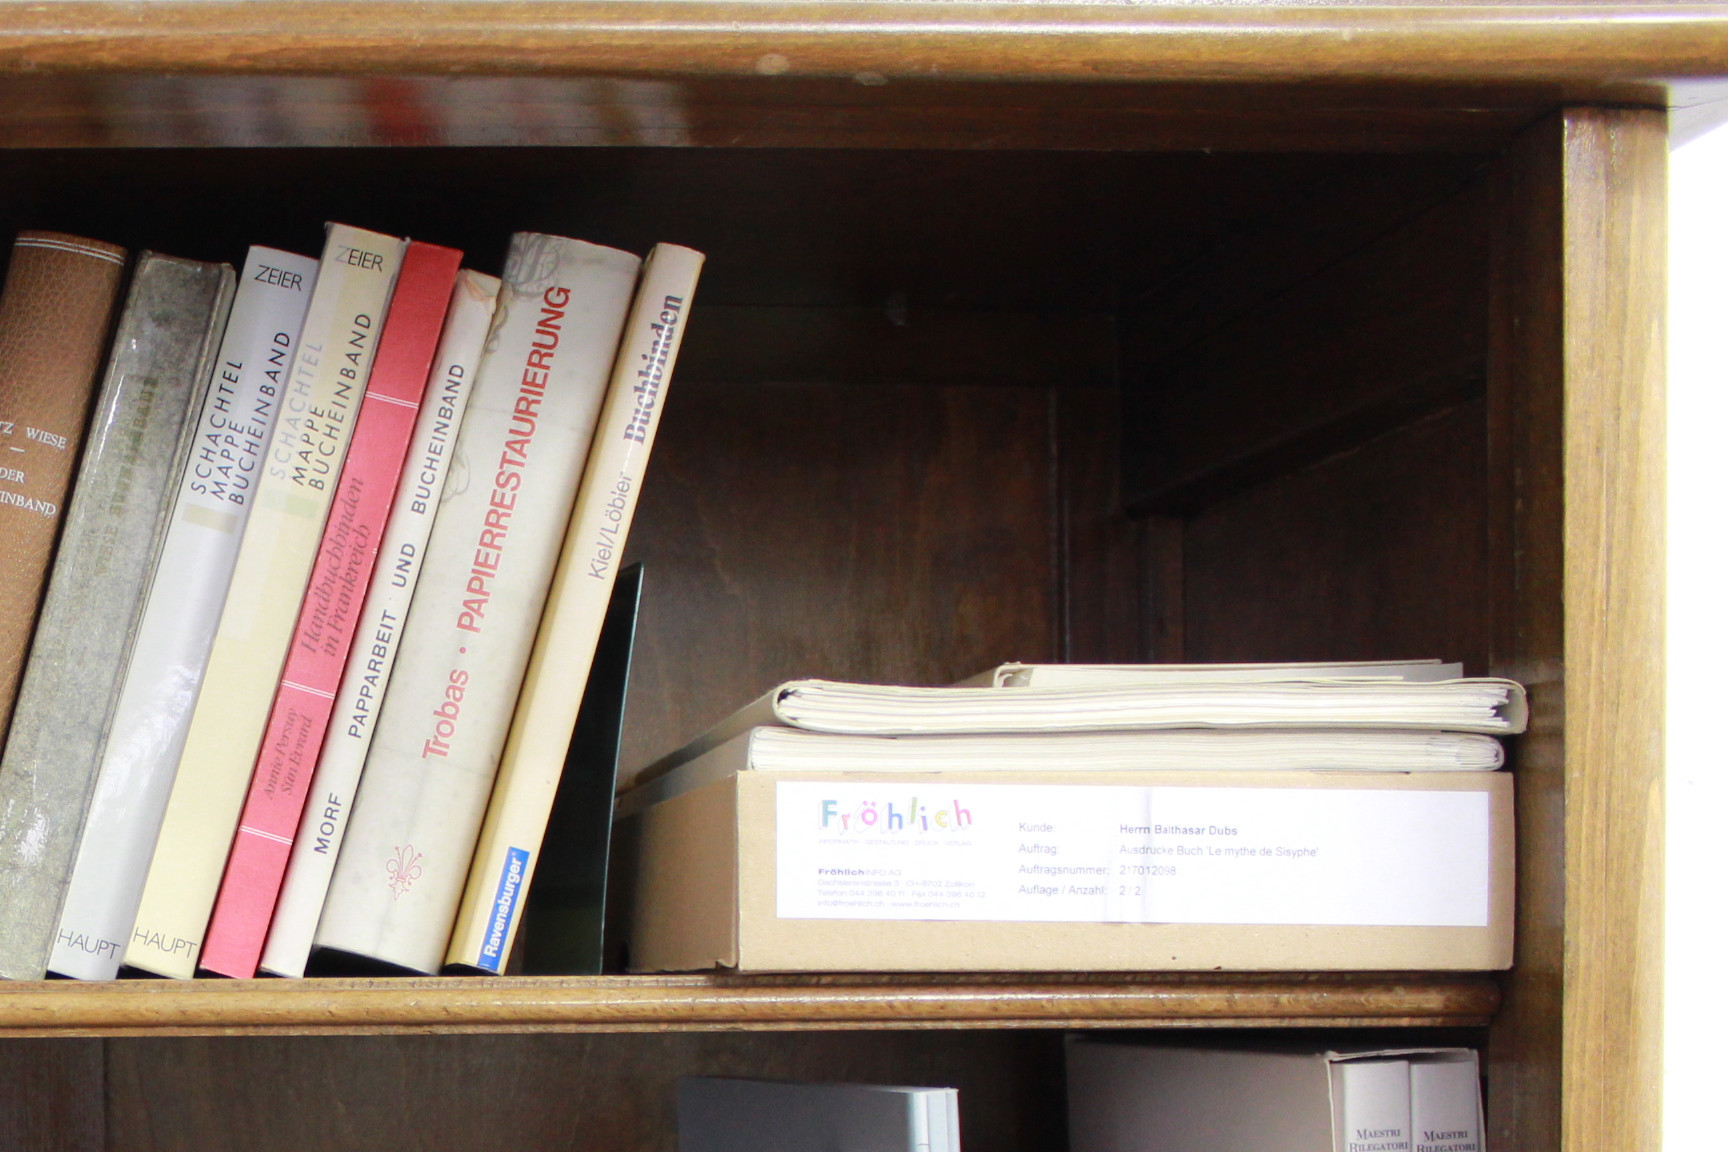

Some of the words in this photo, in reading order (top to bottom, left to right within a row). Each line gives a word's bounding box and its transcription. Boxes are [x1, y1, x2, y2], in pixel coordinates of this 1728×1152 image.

[253, 264, 303, 293] ZEIER
[334, 245, 384, 273] ZEIER
[26, 426, 68, 450] WIESE
[190, 359, 244, 496] SCHACHTEL
[228, 331, 291, 506] BUCHEINBAND
[270, 341, 324, 482] SCHACHTEL
[291, 405, 326, 488] MAPPE
[308, 312, 372, 492] BUCHEINBAND
[587, 471, 636, 582] Kiel/Löbier
[622, 293, 685, 447] Buchbinden
[209, 421, 245, 502] MAPPE
[300, 475, 365, 655] Handbuchbinden
[422, 668, 472, 760] Trobas
[455, 285, 572, 635] PAPIERRESTAURIERUNG
[313, 792, 345, 856] MORF
[347, 609, 398, 739] PAPPARBEIT
[391, 541, 417, 590] UND
[410, 362, 466, 516] BUCHEINBAND
[331, 523, 373, 631] Frankreich
[820, 796, 973, 832] Fröhlich
[1119, 824, 1151, 836] Herrn
[1154, 824, 1206, 837] Balthasar
[1208, 825, 1239, 837] Dubs
[1176, 846, 1204, 857] Buch
[55, 928, 122, 962] HAUPT
[133, 926, 198, 960] HAUPT
[483, 855, 523, 960] Ravensburger
